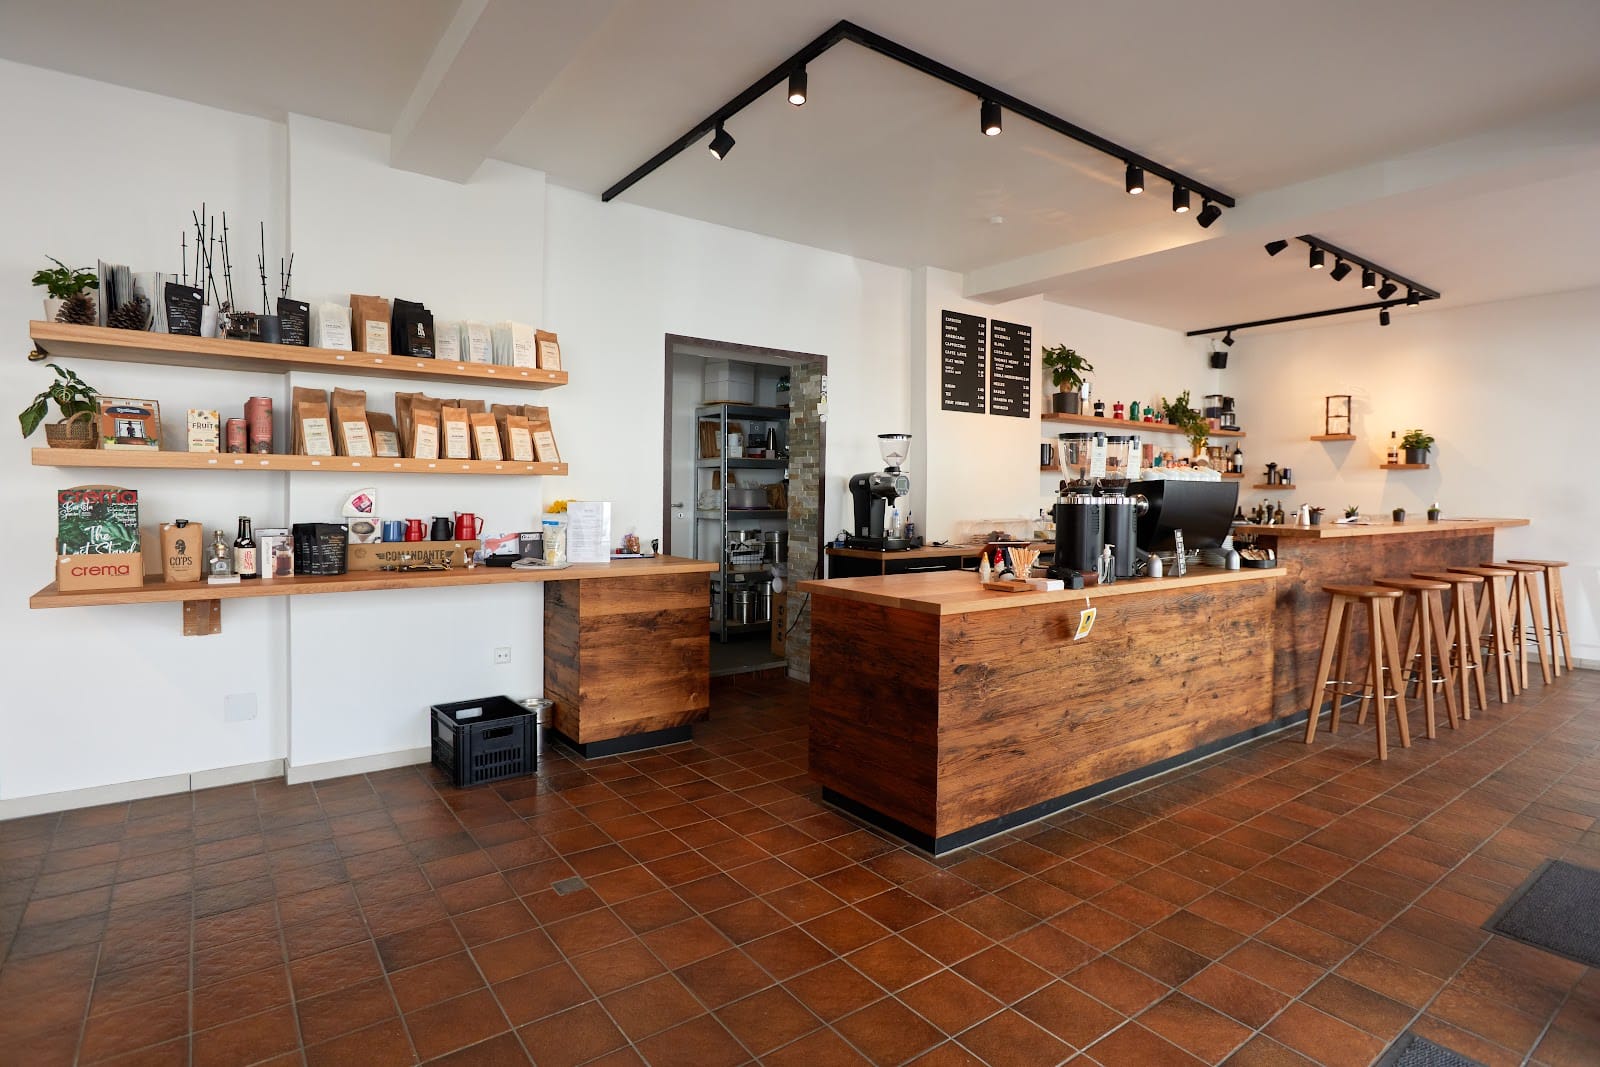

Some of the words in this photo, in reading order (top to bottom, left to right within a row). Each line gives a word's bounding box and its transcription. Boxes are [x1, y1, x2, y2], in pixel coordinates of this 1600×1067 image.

[58, 491, 137, 504] crema
[84, 524, 110, 545] The
[71, 565, 130, 577] crema
